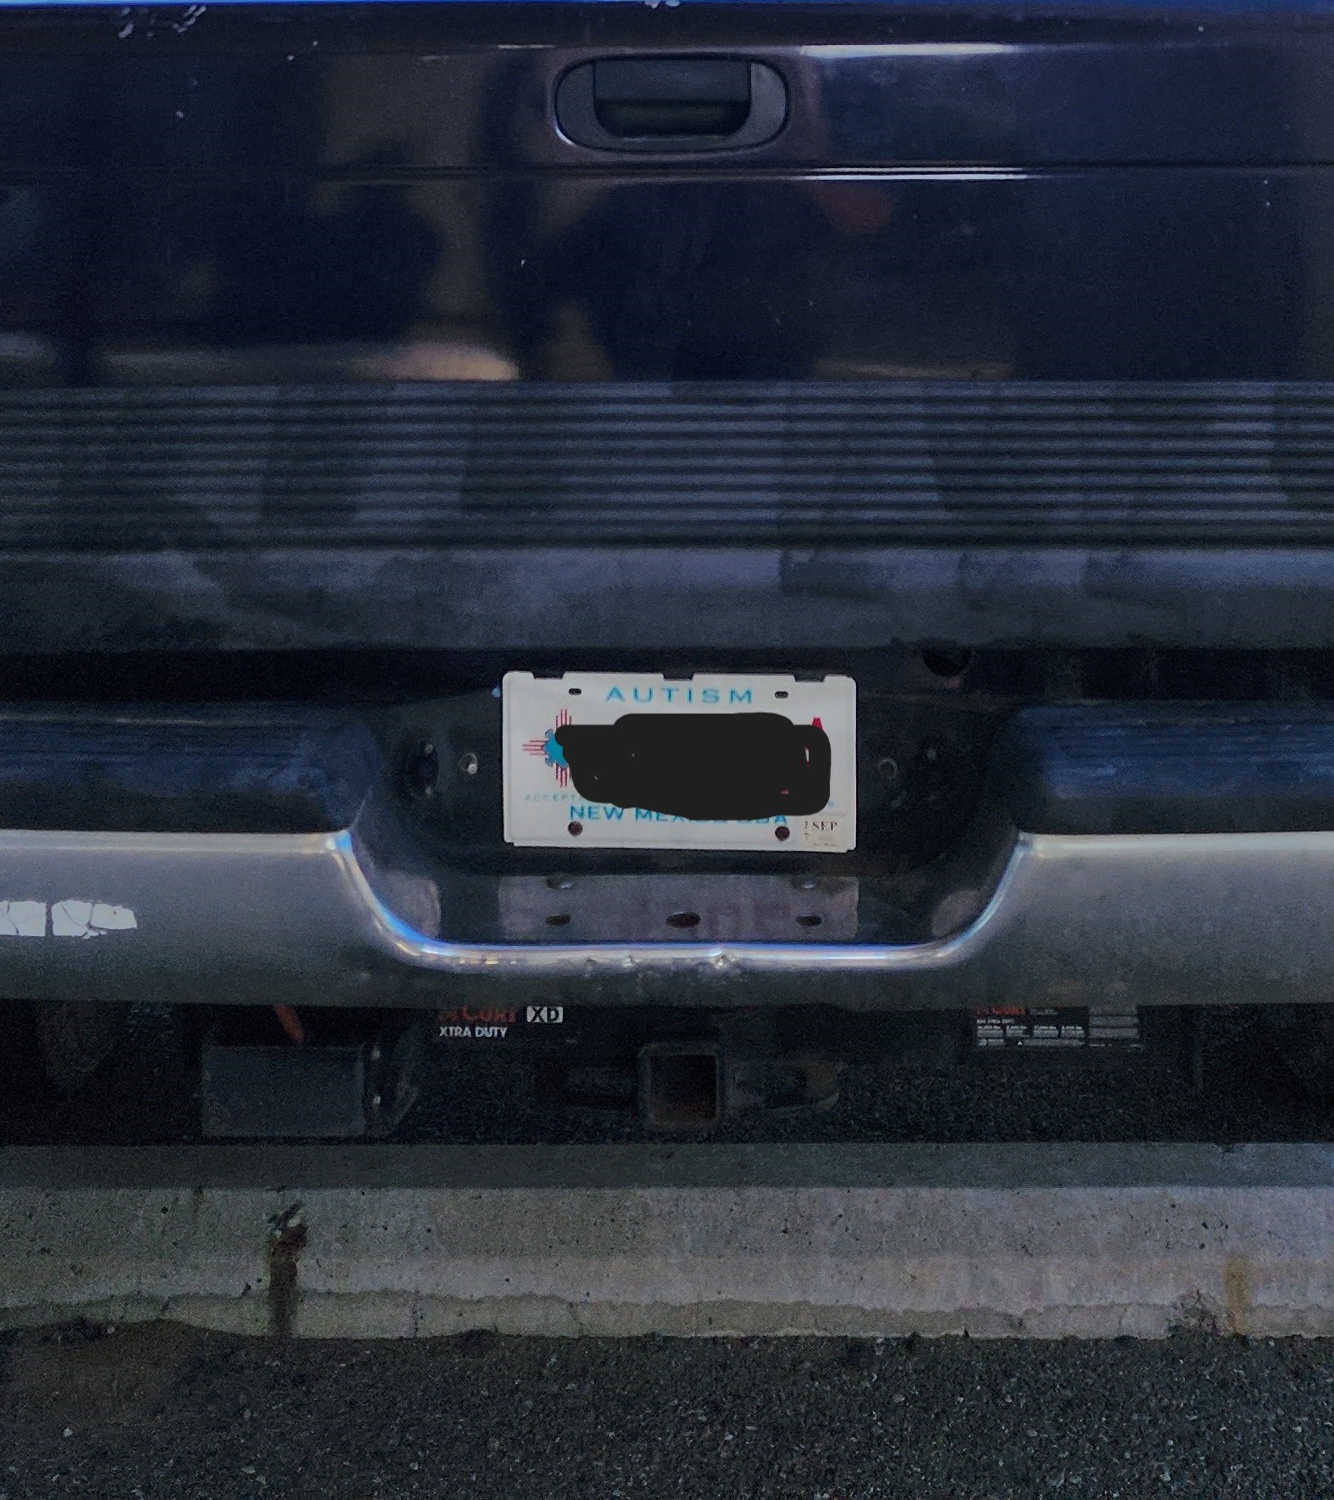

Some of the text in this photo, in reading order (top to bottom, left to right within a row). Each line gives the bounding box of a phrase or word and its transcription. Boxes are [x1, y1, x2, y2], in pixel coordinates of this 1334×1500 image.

[606, 686, 754, 705] AUTISM
[570, 805, 624, 820] NEW
[812, 820, 838, 831] SEP
[530, 1006, 560, 1022] XD
[439, 1026, 508, 1037] XTRA DUTY
